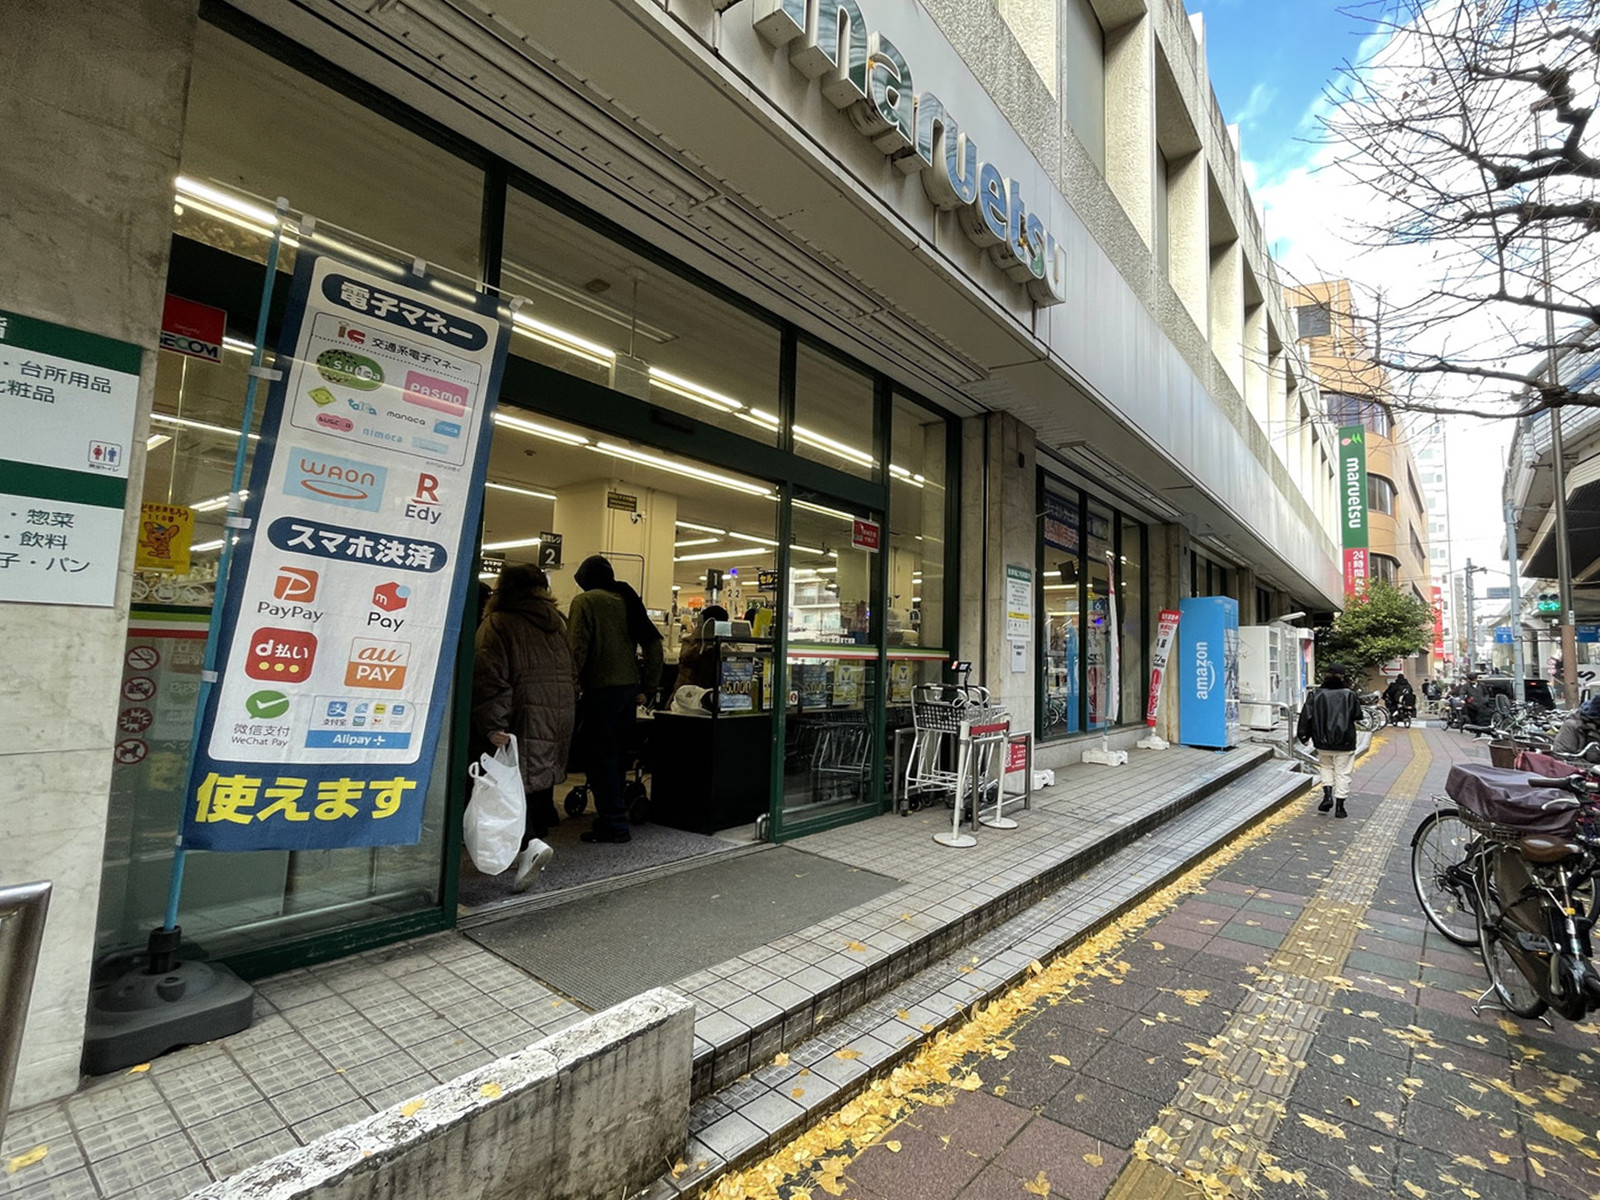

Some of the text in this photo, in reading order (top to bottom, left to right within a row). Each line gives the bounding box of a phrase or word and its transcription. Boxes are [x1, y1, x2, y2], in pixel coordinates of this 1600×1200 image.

[340, 282, 473, 340] 電子マネー
[160, 332, 219, 358] ECOM
[371, 337, 462, 372] 交通系電子マネー
[333, 360, 381, 381] Suica
[386, 410, 427, 426] manaca
[362, 427, 403, 443] nimoca
[301, 458, 375, 486] WAON
[416, 472, 439, 502] R
[1346, 457, 1363, 529] maruetsu
[404, 504, 442, 524] Edy
[286, 524, 436, 570] スマホ決済
[545, 548, 556, 565] 2
[256, 601, 324, 624] PayPay
[367, 611, 405, 632] Pay
[255, 639, 309, 660] d払い
[357, 646, 403, 663] au
[355, 665, 397, 682] PAY
[1196, 641, 1209, 700] amazon
[233, 723, 290, 738] 微信支付
[231, 735, 288, 748] WeChat Pay
[195, 772, 418, 825] 使えます
